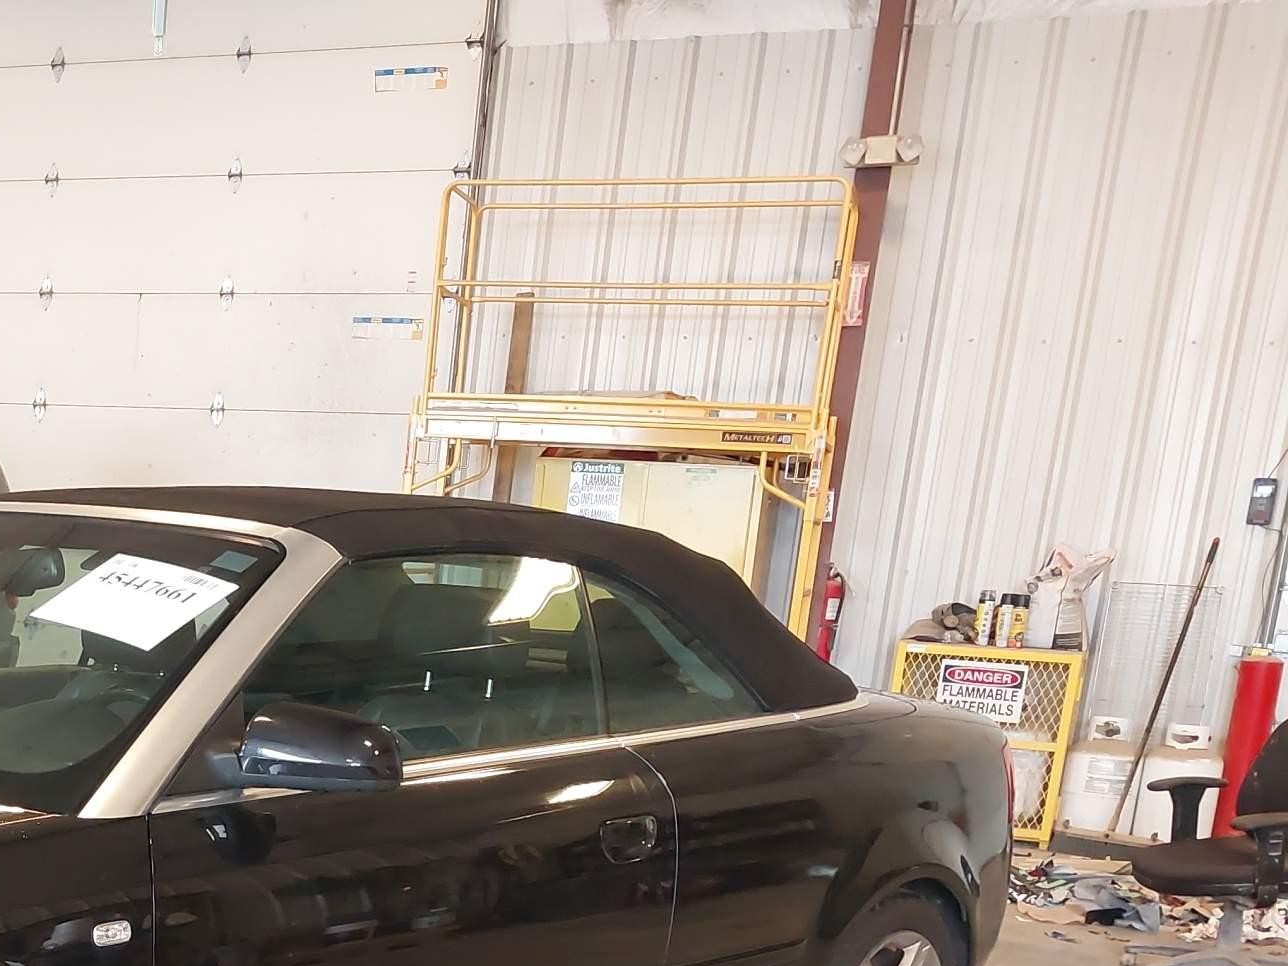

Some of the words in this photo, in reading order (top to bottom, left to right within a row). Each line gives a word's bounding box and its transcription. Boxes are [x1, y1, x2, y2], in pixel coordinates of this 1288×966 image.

[583, 463, 622, 474] Justrite
[582, 473, 621, 487] FLAMMABLE
[98, 571, 197, 603] 45447661
[954, 669, 1013, 684] DANGER
[942, 684, 1019, 702] FLAMMABLE
